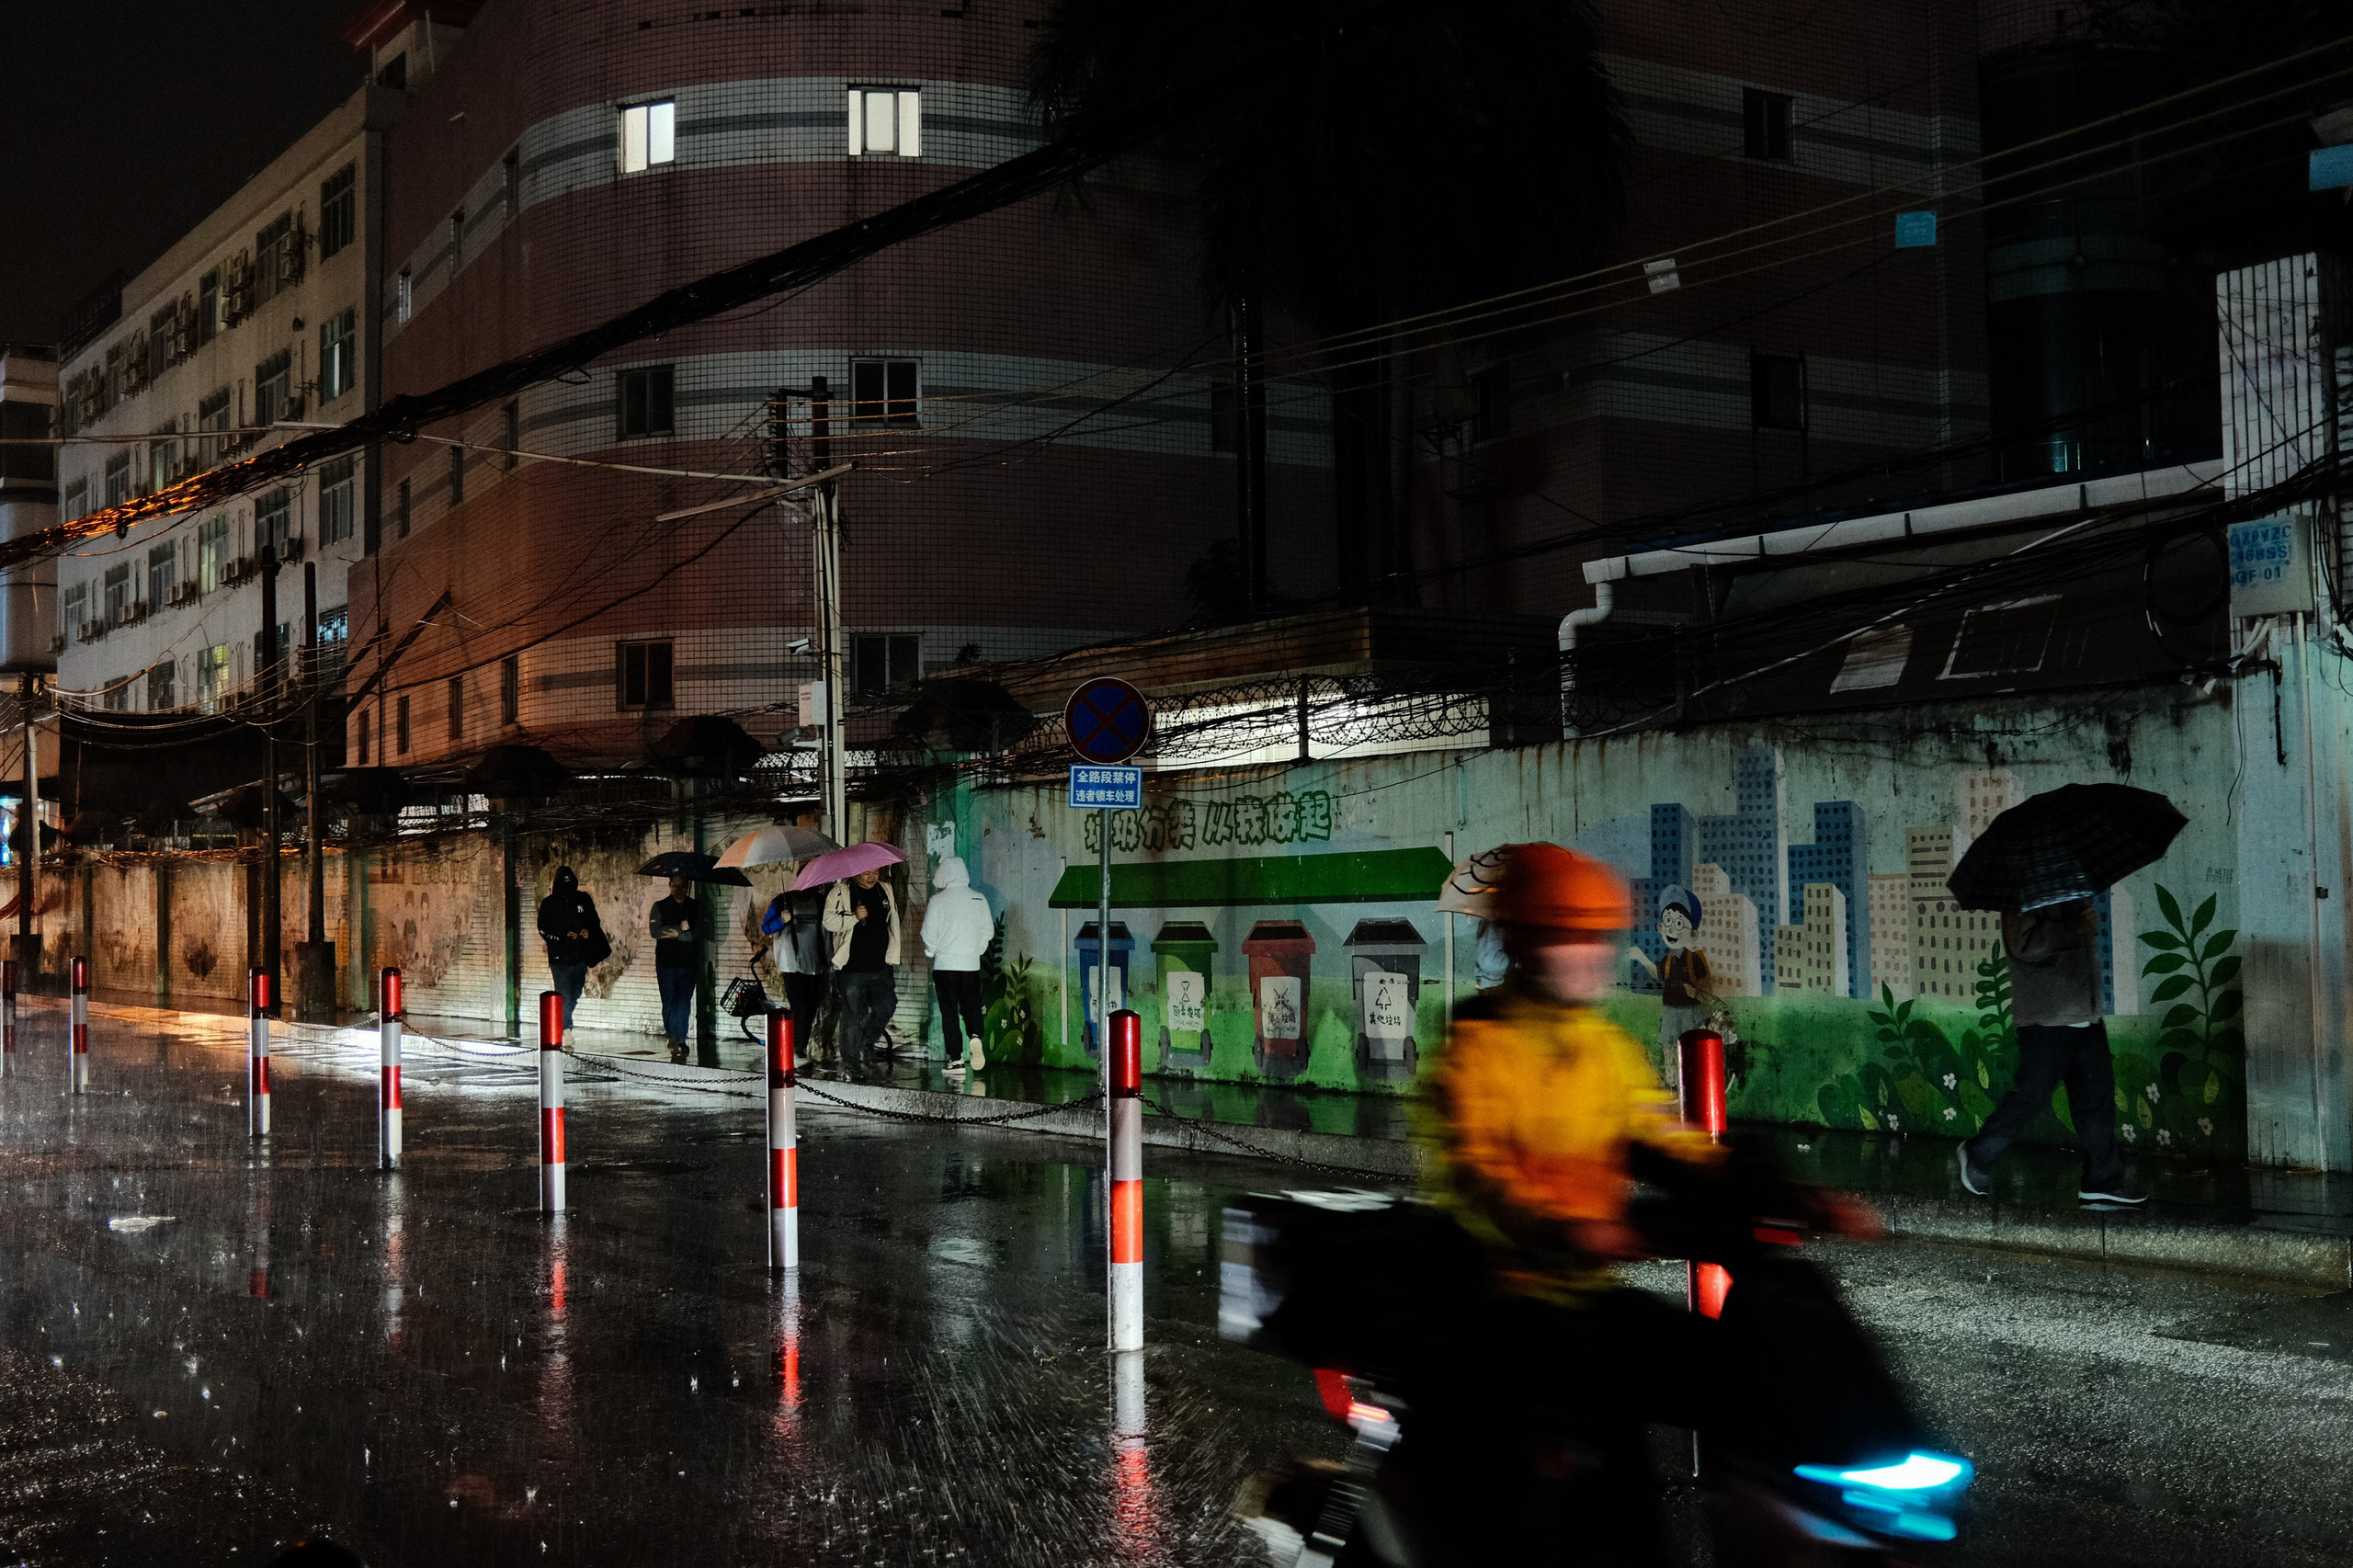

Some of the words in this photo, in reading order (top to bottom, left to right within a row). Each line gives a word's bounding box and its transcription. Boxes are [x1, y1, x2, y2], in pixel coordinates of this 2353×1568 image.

[2264, 566, 2281, 580] 01
[1077, 770, 1136, 784] 全路段禁停
[1075, 790, 1135, 802] 违者锁车处理
[1370, 1011, 1401, 1026] 其他垃圾
